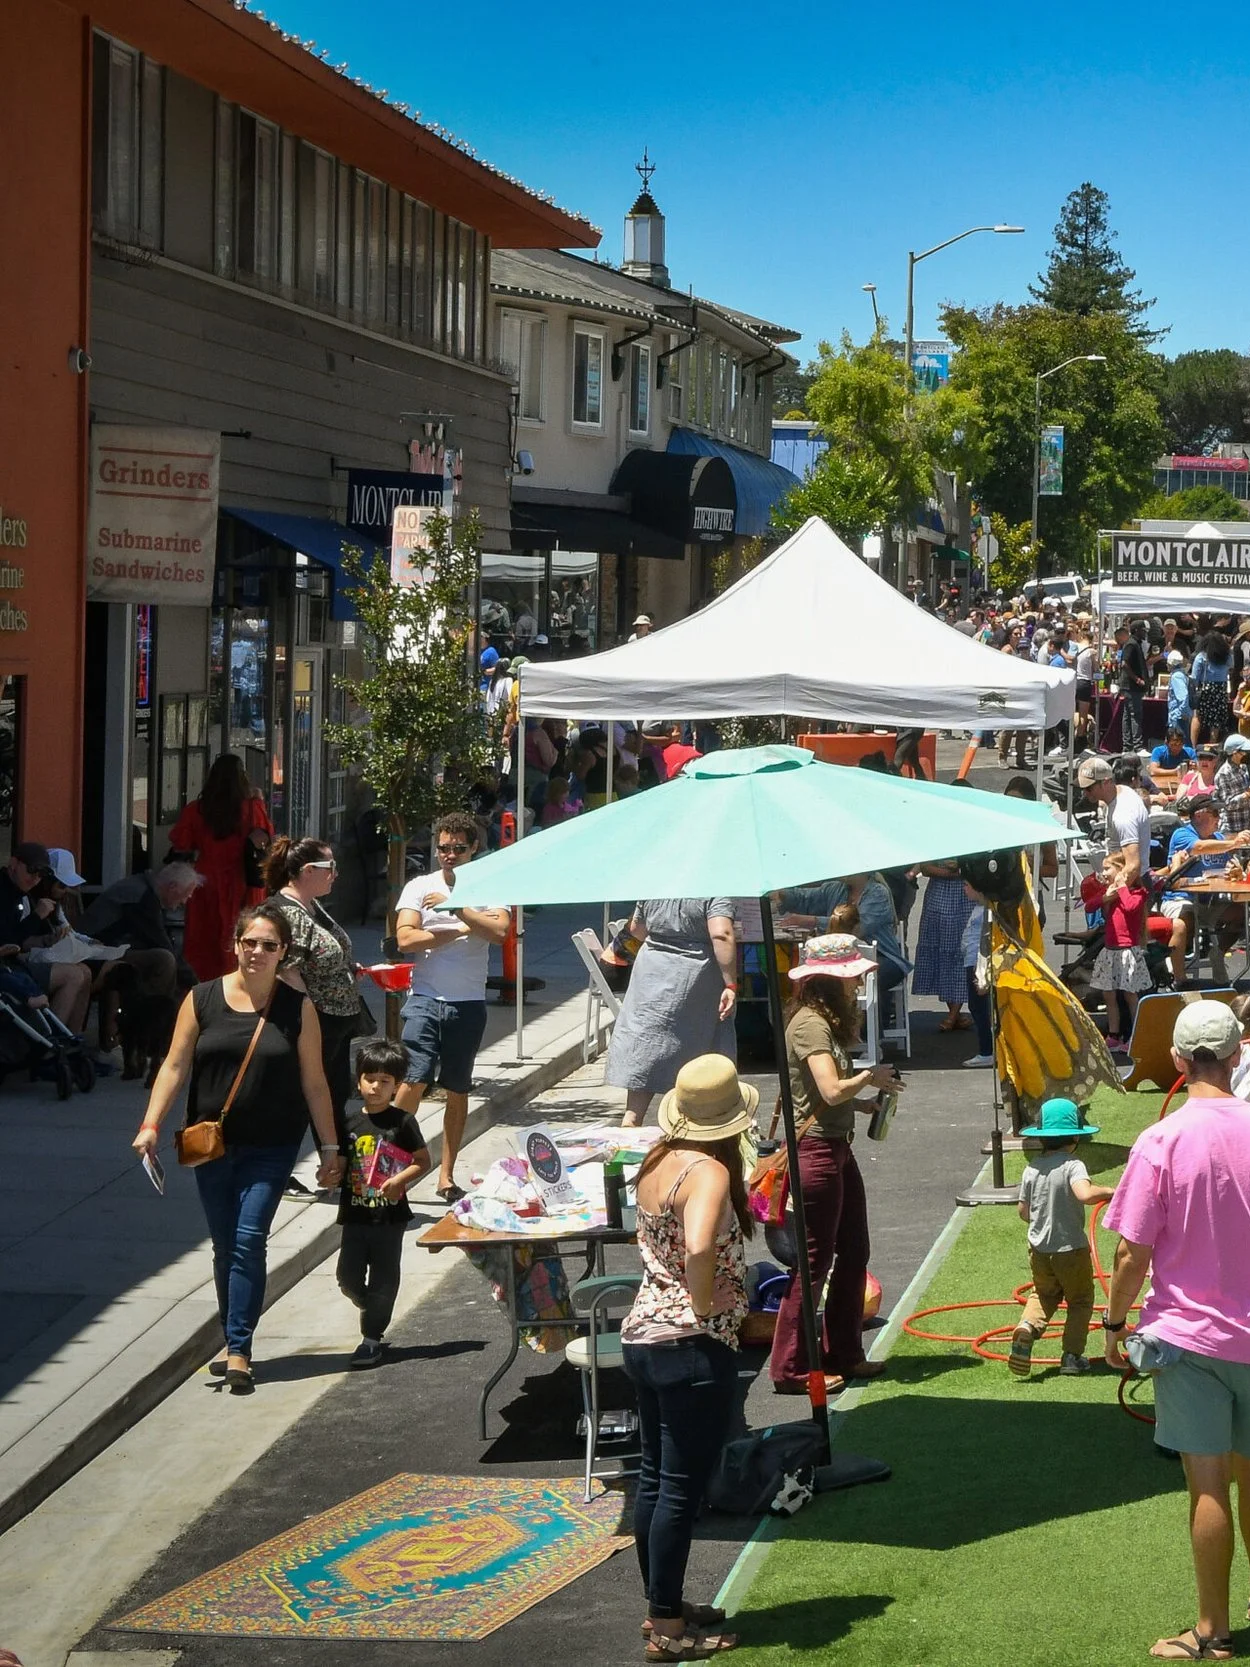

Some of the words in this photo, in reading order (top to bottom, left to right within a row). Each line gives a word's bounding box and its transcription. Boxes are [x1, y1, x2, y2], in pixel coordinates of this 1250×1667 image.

[100, 459, 211, 490] Grinders
[396, 511, 418, 530] NO
[693, 506, 734, 531] HIGHWIRE
[98, 527, 203, 554] Submarine
[92, 557, 205, 583] Sandwiches
[1117, 571, 1142, 584] BEER,
[1144, 572, 1168, 583] WINE
[1171, 573, 1178, 582] &
[1182, 572, 1210, 584] MUSIC
[543, 1180, 573, 1198] STICKERS
